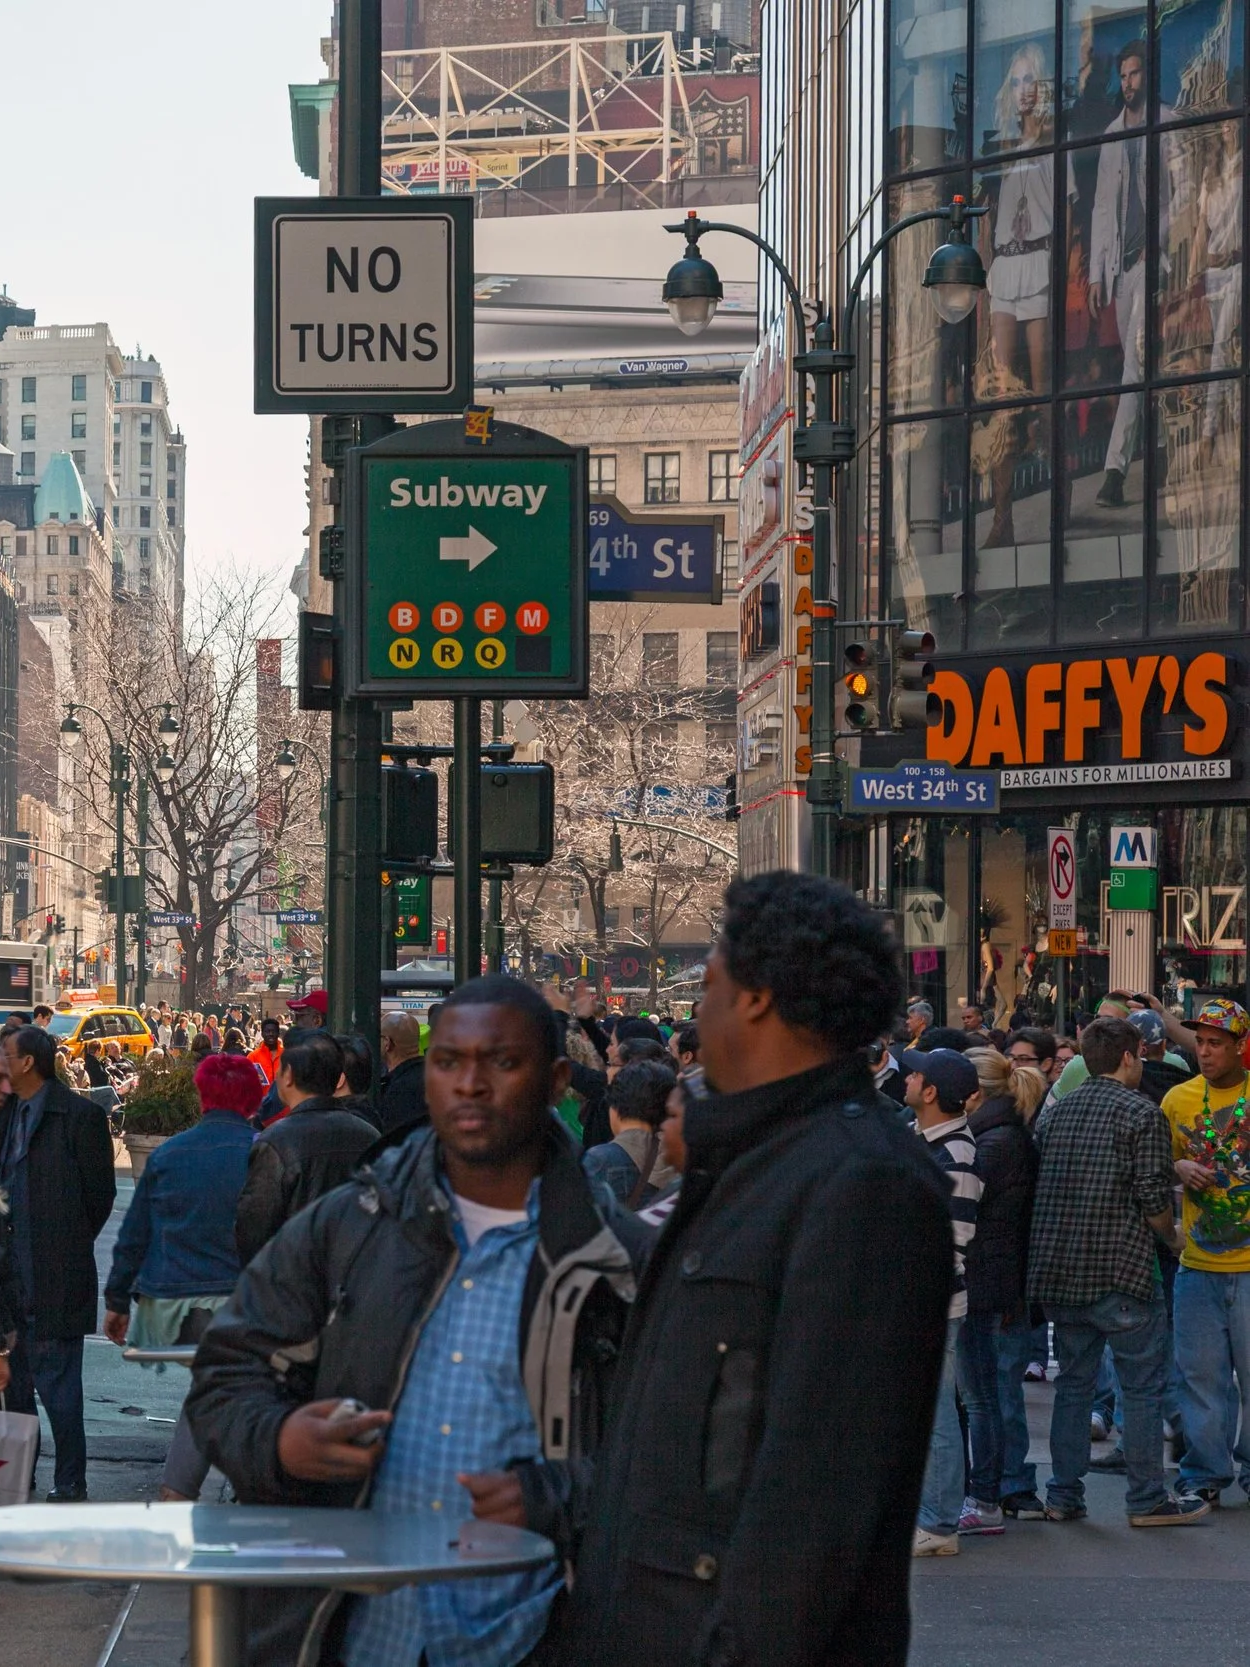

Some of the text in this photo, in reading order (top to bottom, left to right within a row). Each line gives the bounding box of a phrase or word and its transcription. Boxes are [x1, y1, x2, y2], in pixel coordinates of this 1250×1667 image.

[487, 163, 508, 172] Sprint
[326, 246, 402, 294] NO
[289, 322, 439, 363] TURNS
[625, 361, 684, 373] Van Wagner
[389, 476, 548, 516] Subway
[589, 533, 695, 579] 4th St
[397, 608, 541, 627] B D F M
[396, 644, 498, 665] N R Q
[926, 652, 1228, 767] DAFFY'S
[904, 767, 920, 776] 100
[929, 767, 946, 776] 158
[1004, 761, 1226, 787] BARGAINS FOR MILLIONAIRES
[862, 778, 987, 802] West 34th St
[153, 915, 193, 924] West 33rd St
[280, 912, 317, 922] West 33rd St
[1053, 904, 1073, 916] EXCEPT
[1055, 935, 1071, 951] NEW
